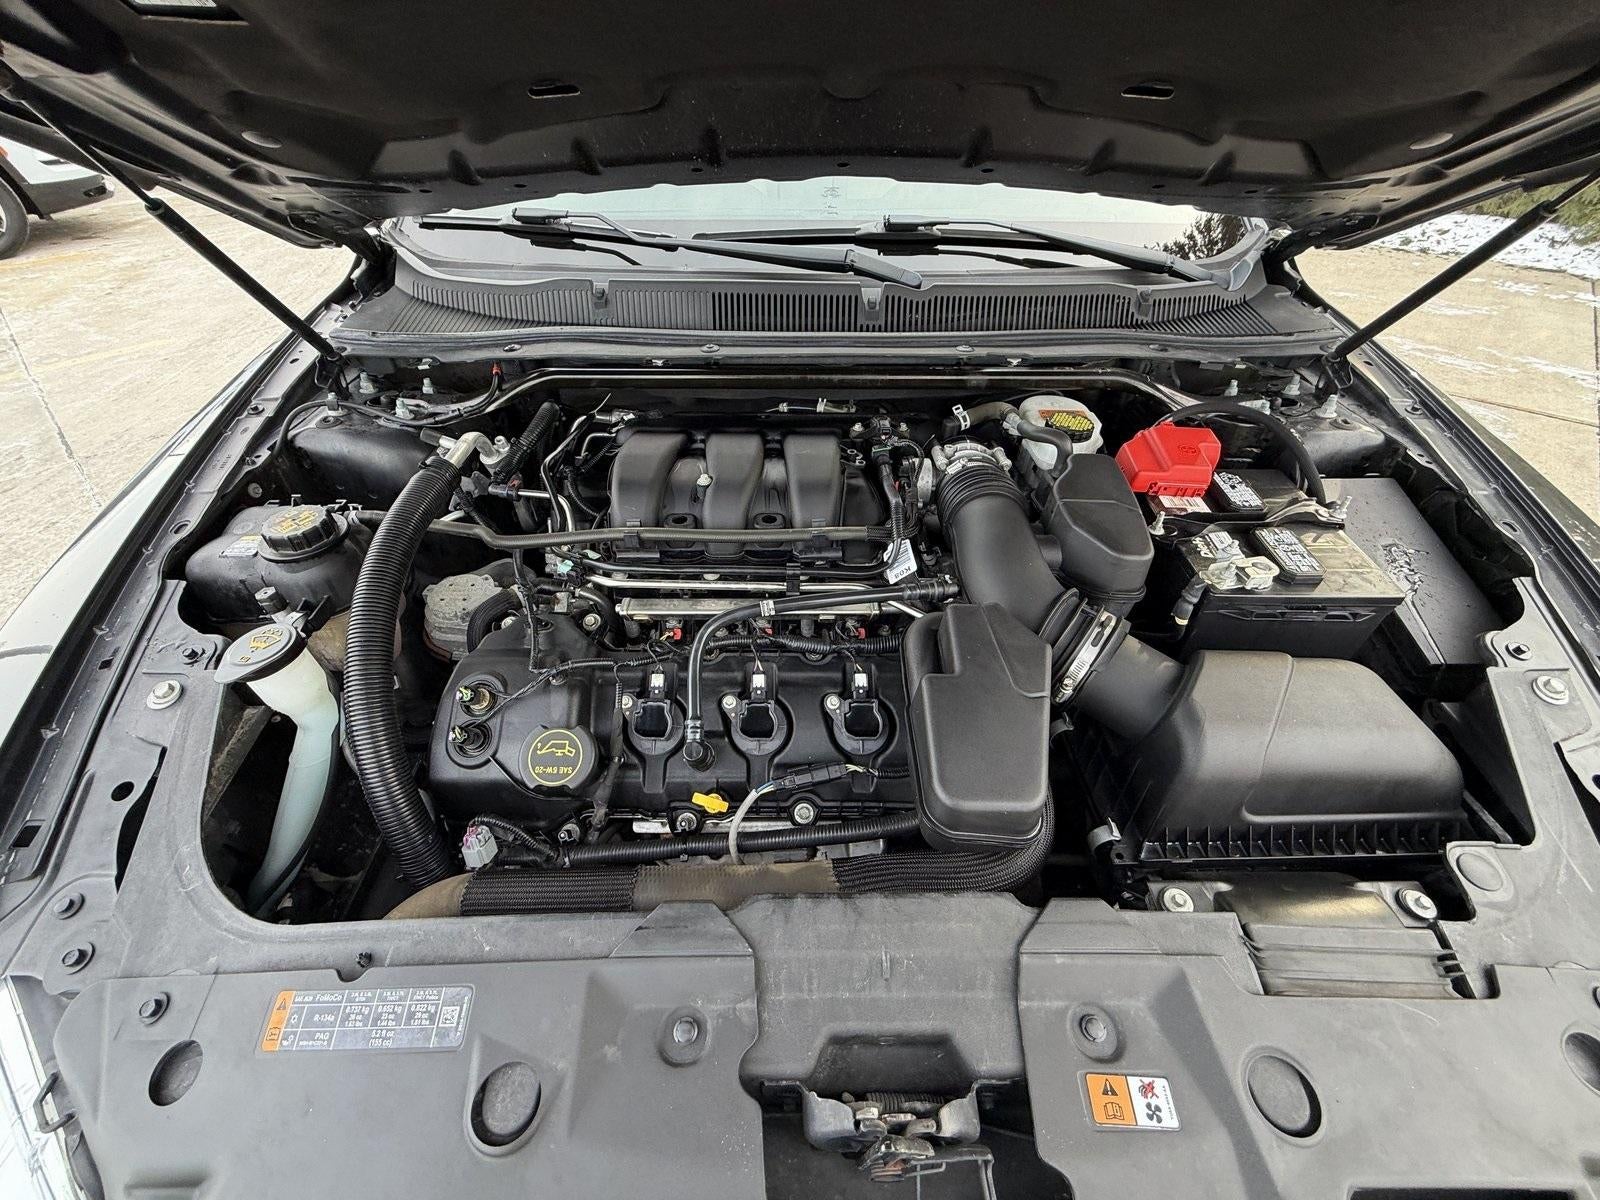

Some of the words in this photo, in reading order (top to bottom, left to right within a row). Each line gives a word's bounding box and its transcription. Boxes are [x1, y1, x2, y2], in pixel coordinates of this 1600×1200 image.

[535, 766, 558, 774] 5W-20
[559, 766, 572, 774] SAE
[316, 993, 343, 1002] FoMoCo
[394, 1005, 402, 1013] kg
[428, 1004, 436, 1012] kg
[315, 1032, 329, 1040] PAG
[371, 1030, 381, 1038] 5.2
